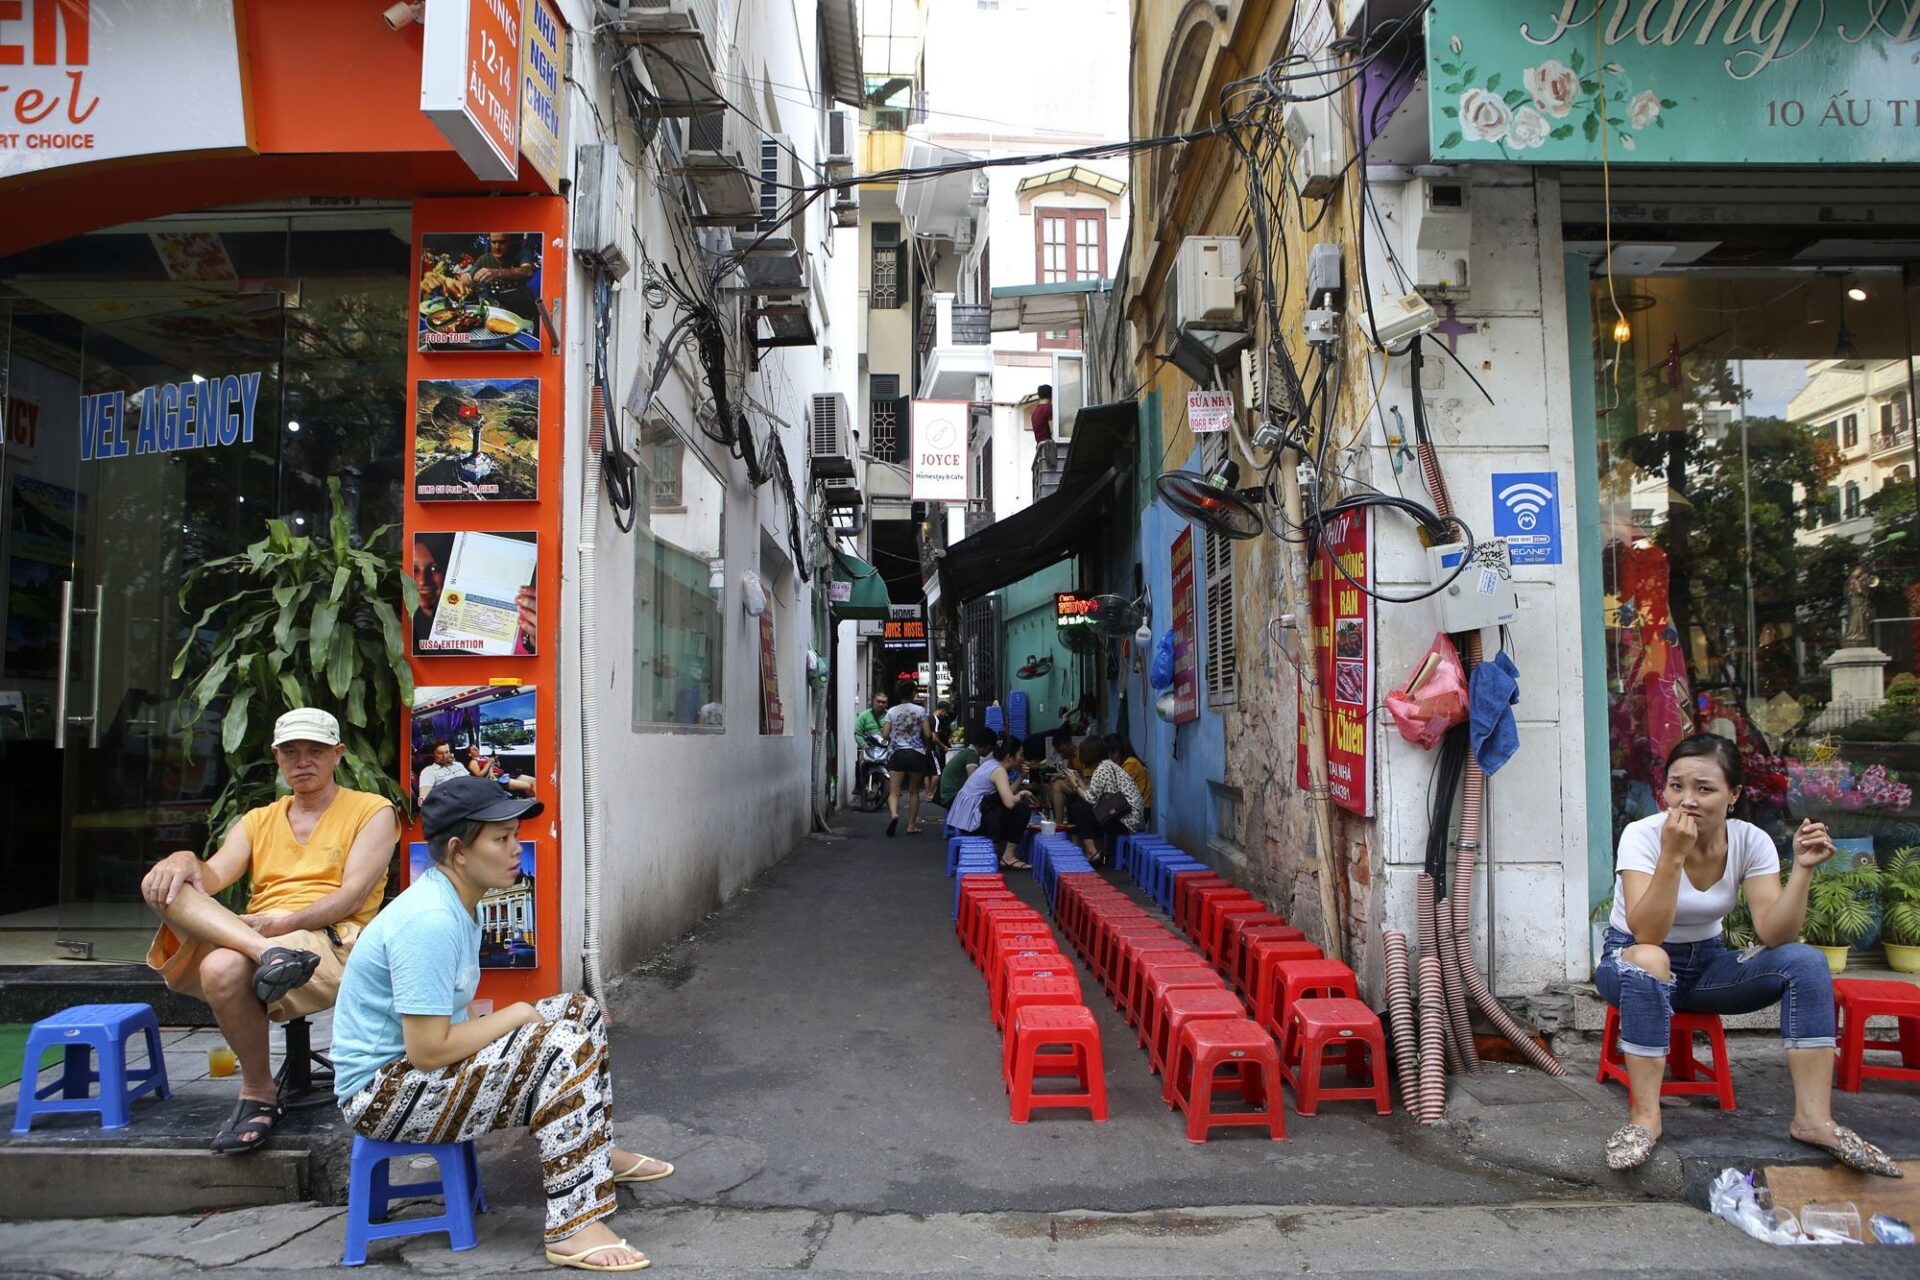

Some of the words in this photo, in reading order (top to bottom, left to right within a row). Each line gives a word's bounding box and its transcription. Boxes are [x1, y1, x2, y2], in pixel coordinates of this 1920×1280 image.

[480, 30, 511, 97] 12-14
[530, 38, 558, 96] NGHỈ
[0, 70, 100, 125] el
[1767, 100, 1805, 127] 10
[1819, 89, 1872, 127] ẤU
[1887, 99, 1920, 127] T
[487, 91, 515, 146] TRIỆU
[26, 134, 94, 149] CHOICE
[425, 332, 448, 344] FOOD
[448, 332, 471, 344] TOUR
[80, 390, 129, 461] VEL
[136, 372, 261, 455] AGENCY
[921, 453, 960, 466] JOYCE
[892, 609, 916, 619] HOME
[1339, 586, 1358, 616] RÁN
[419, 639, 441, 650] VISA
[441, 639, 485, 650] EXTENTION
[884, 622, 902, 638] JOYCE
[903, 621, 924, 638] HOSTEL
[1336, 707, 1364, 756] Chiên
[1338, 762, 1352, 782] NHÀ
